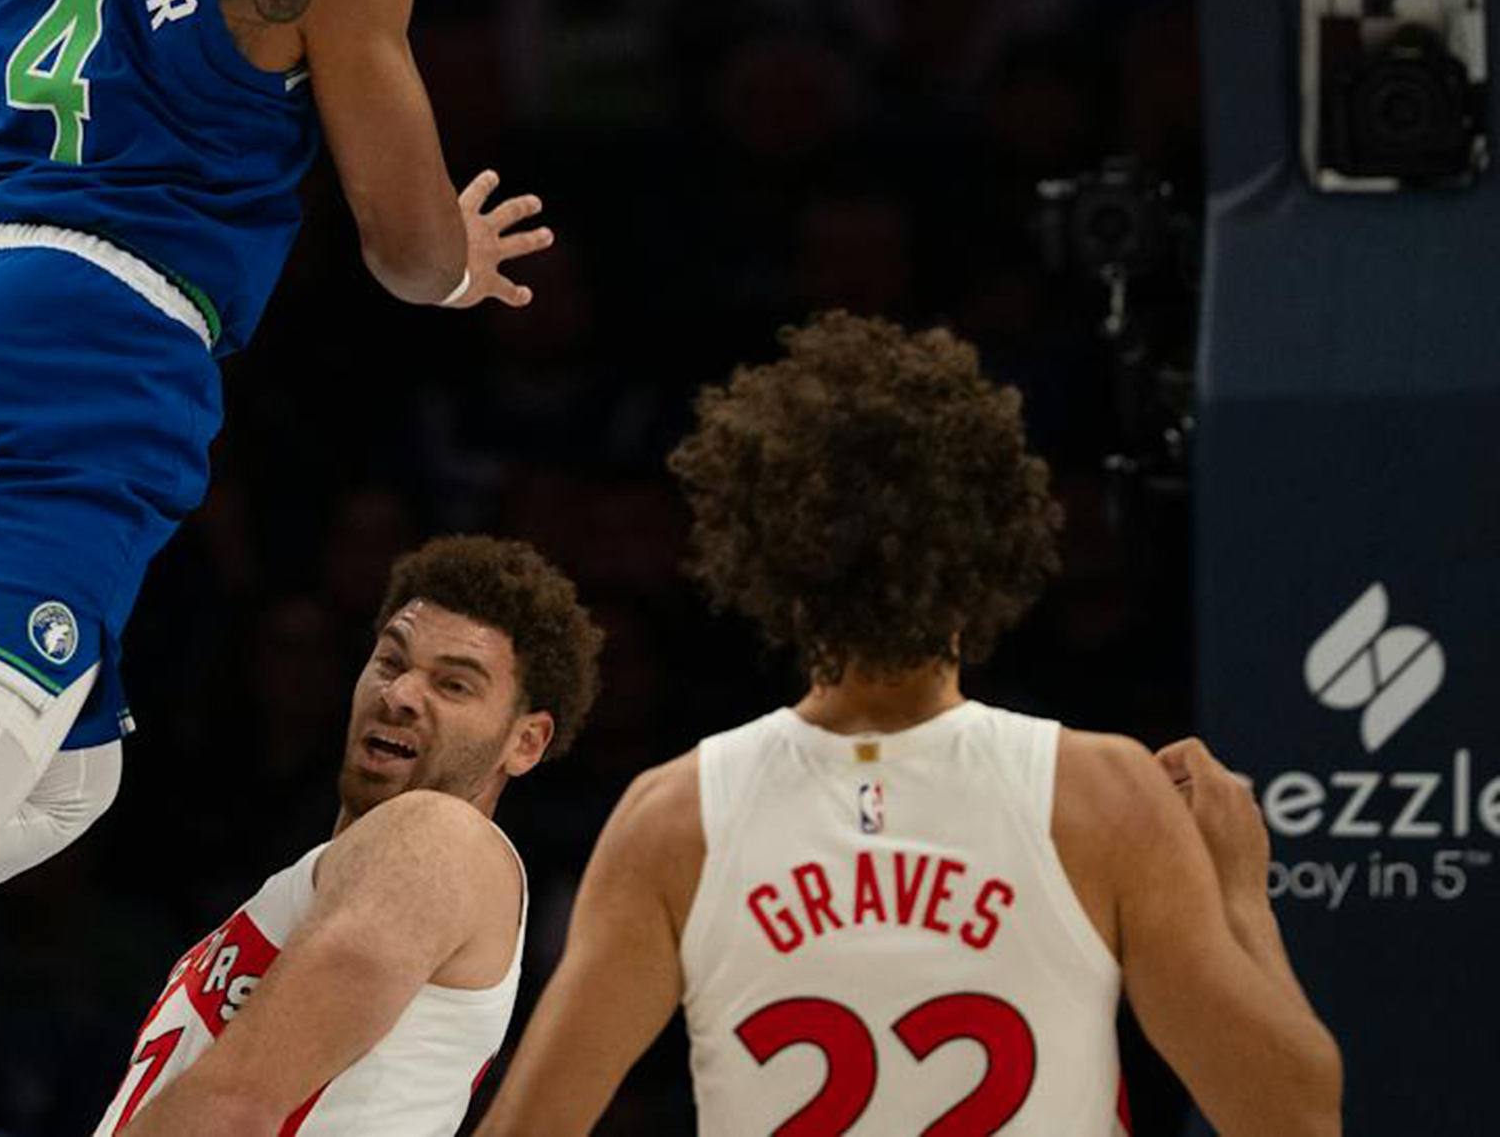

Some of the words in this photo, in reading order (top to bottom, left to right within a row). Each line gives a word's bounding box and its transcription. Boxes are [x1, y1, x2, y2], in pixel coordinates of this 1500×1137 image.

[1262, 748, 1500, 838] ezzl
[746, 850, 1015, 954] GRAVES
[1368, 851, 1418, 898] in
[734, 991, 1037, 1137] 22
